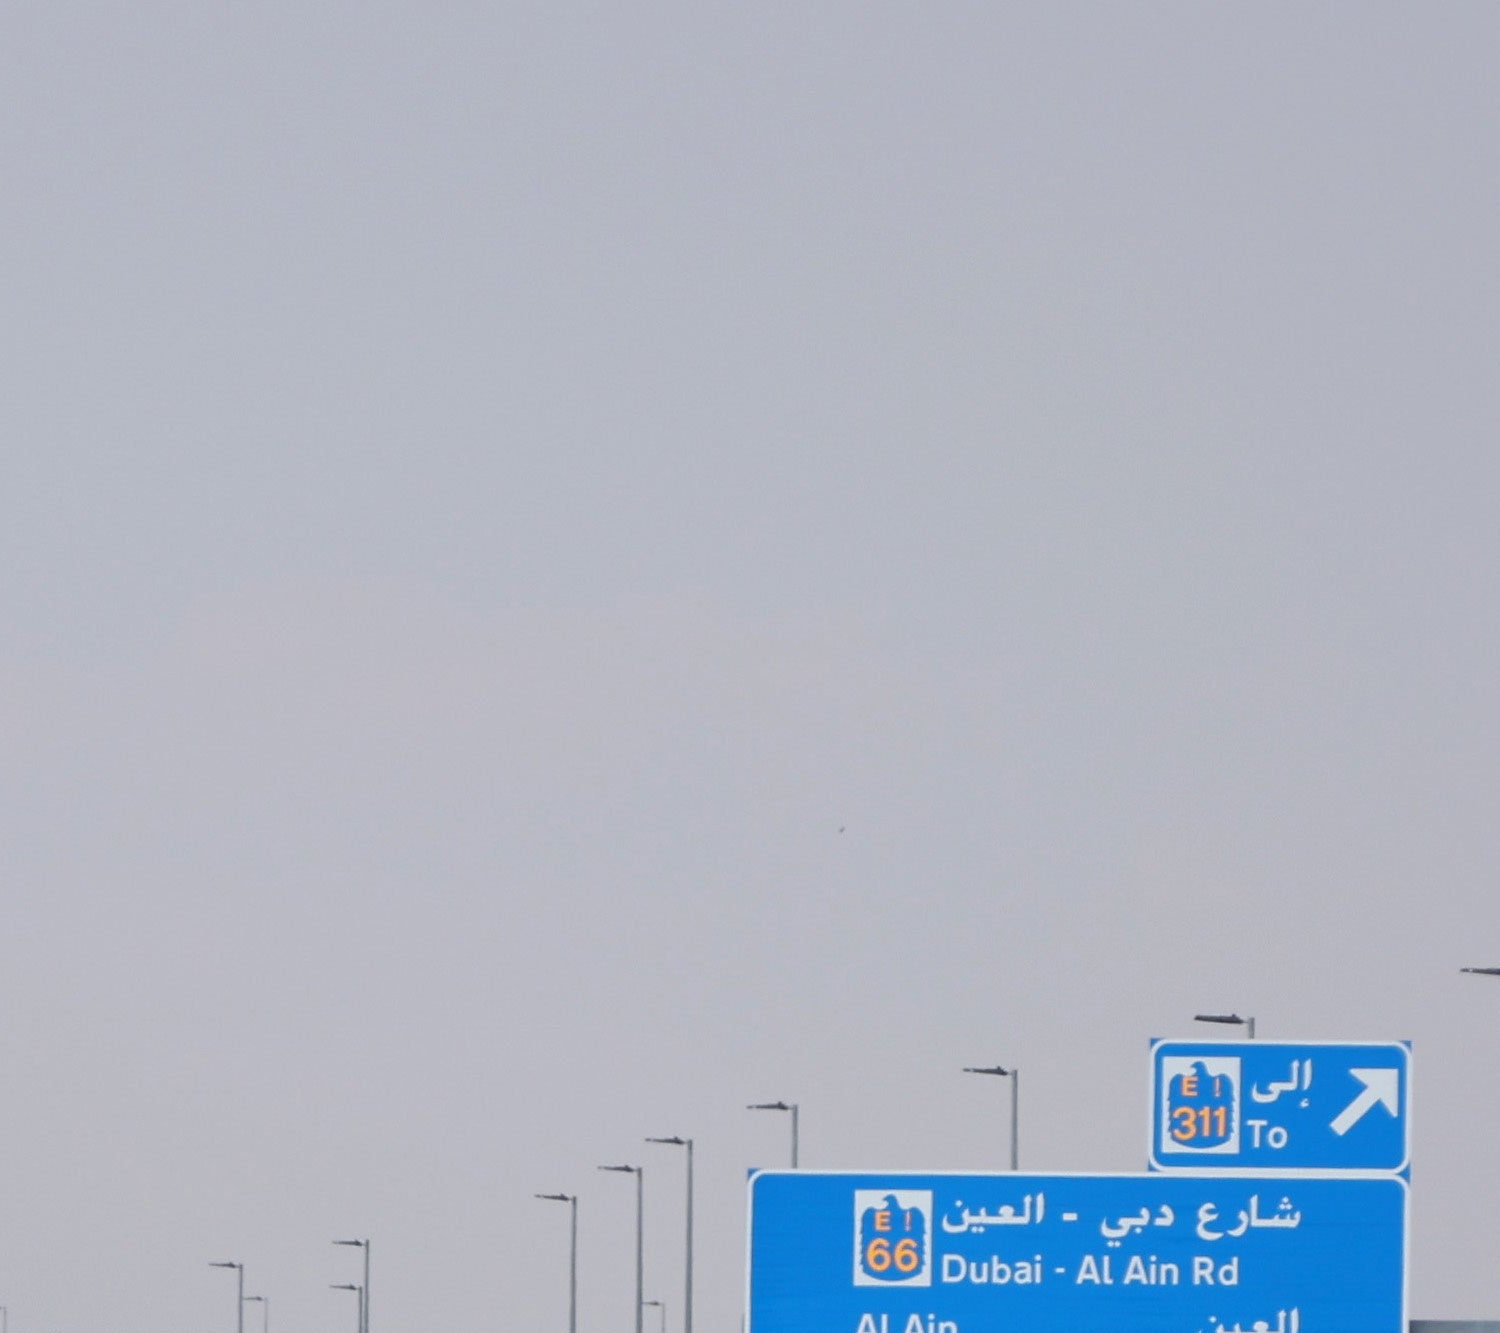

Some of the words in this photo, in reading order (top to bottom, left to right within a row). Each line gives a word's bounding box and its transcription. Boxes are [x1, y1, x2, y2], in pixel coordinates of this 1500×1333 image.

[1181, 1075, 1198, 1097] E
[1252, 1058, 1313, 1109] إلى
[1172, 1105, 1228, 1141] 311
[1247, 1119, 1289, 1149] To
[874, 1209, 891, 1232] E
[942, 1193, 1045, 1235] العين
[1101, 1201, 1175, 1248] دبي
[1195, 1193, 1301, 1241] شارع
[866, 1238, 919, 1272] 66
[941, 1253, 1043, 1285] Dubai
[1075, 1254, 1113, 1286] Al
[1123, 1255, 1180, 1286] Ain
[1193, 1256, 1239, 1287] Rd
